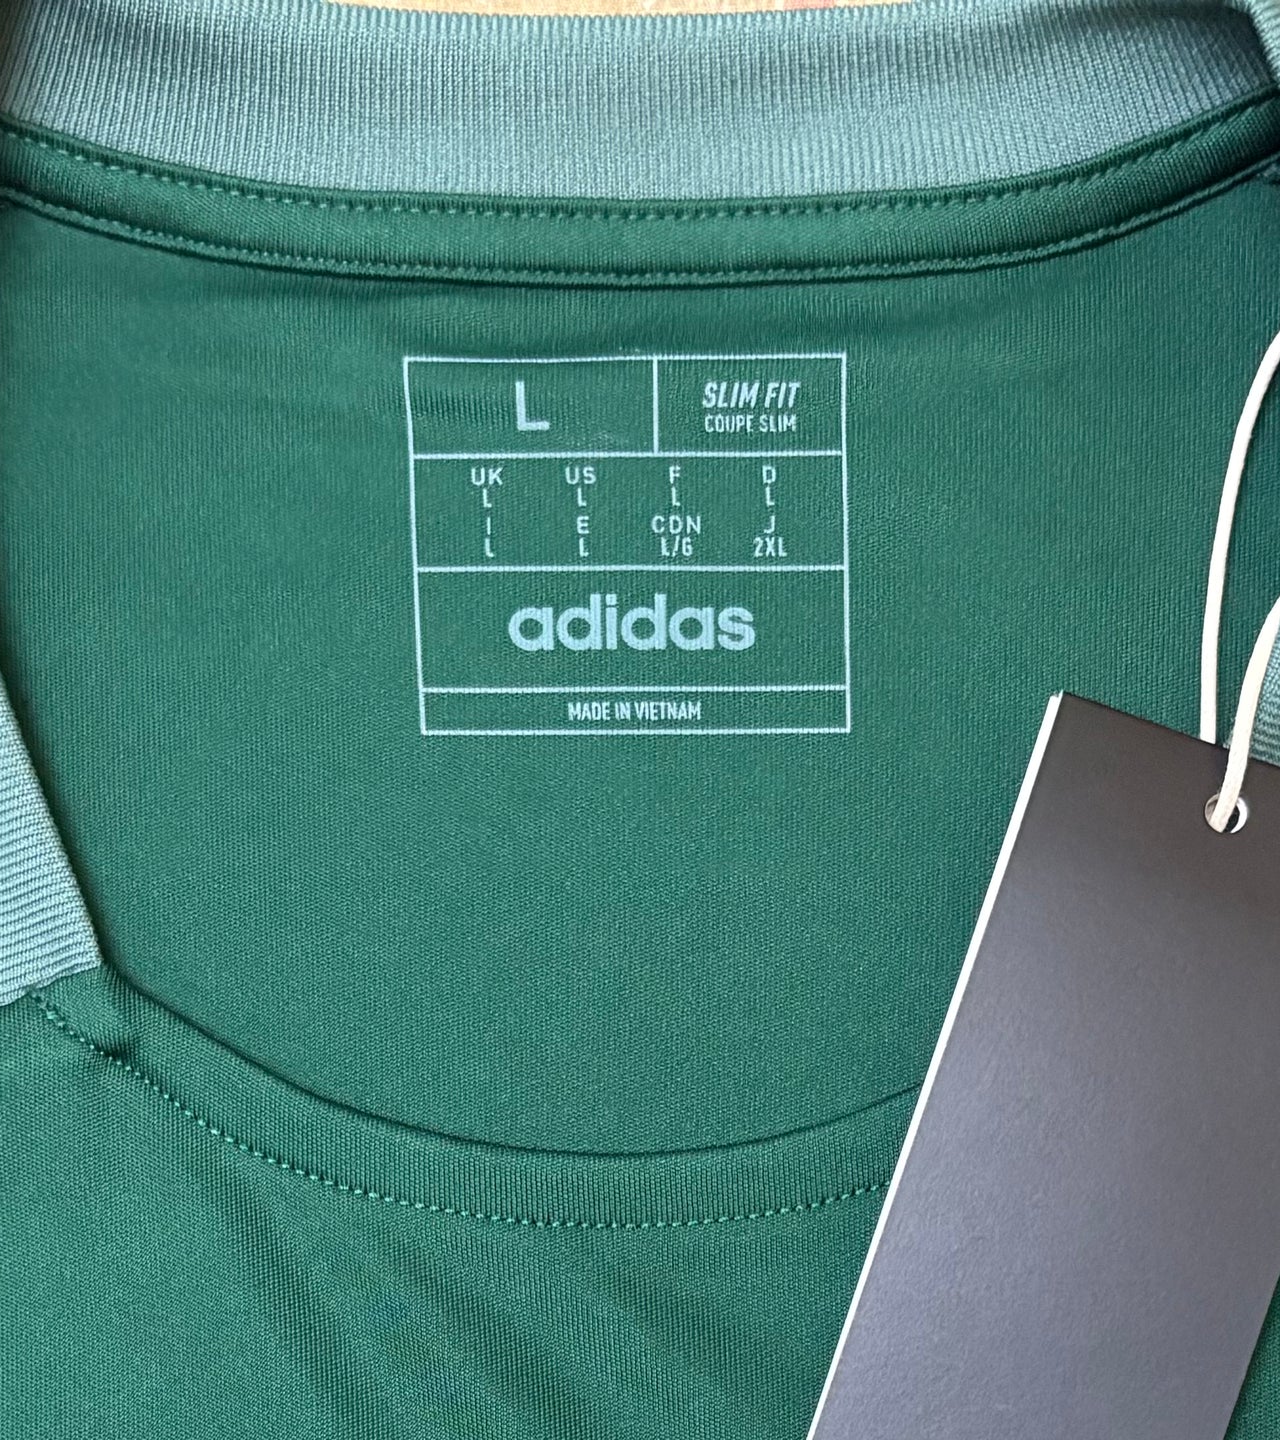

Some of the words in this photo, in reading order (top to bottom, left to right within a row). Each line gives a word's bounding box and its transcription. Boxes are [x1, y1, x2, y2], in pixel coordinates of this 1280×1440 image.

[702, 382, 760, 408] SLIM
[764, 381, 801, 408] FIT
[516, 381, 550, 431] L
[704, 414, 753, 433] COUPE
[759, 414, 797, 433] SLIM
[471, 467, 503, 486] UK
[565, 466, 596, 485] US
[669, 466, 681, 484] F
[763, 465, 776, 484] D
[482, 488, 493, 508] L
[577, 488, 587, 507] L
[671, 487, 681, 506] L
[765, 487, 775, 506] L
[486, 516, 492, 535] I
[577, 516, 590, 534] E
[651, 515, 702, 534] CDN
[764, 515, 776, 534] J
[484, 538, 495, 558] L
[579, 538, 590, 557] L
[661, 536, 693, 557] L/G
[753, 537, 788, 557] 2XL
[508, 593, 756, 652] adidas
[568, 701, 611, 721] MADE
[615, 701, 631, 720] IN
[634, 701, 702, 721] VIETNAM
